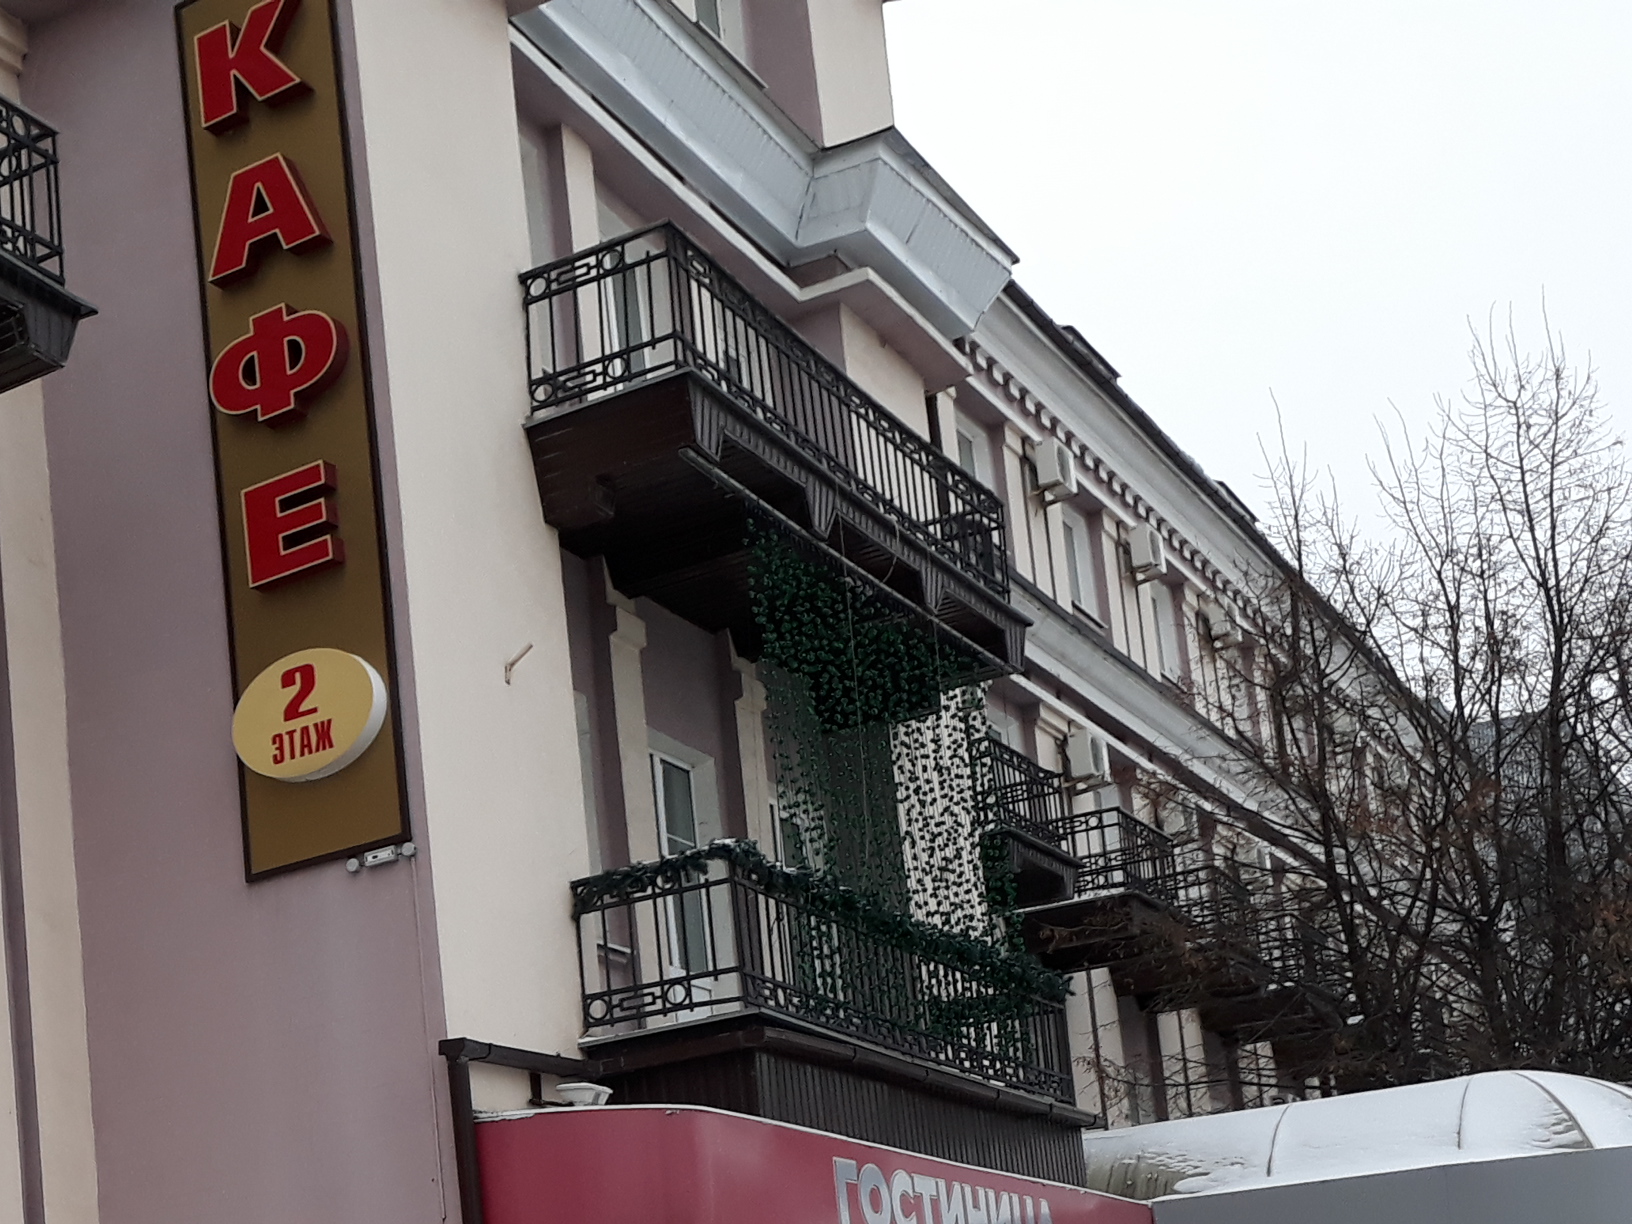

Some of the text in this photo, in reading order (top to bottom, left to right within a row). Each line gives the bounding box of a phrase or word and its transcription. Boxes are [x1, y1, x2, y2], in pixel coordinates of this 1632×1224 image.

[194, 0, 346, 590] КАФЕ
[280, 663, 318, 723] 2
[271, 718, 334, 765] ЭТАЖ
